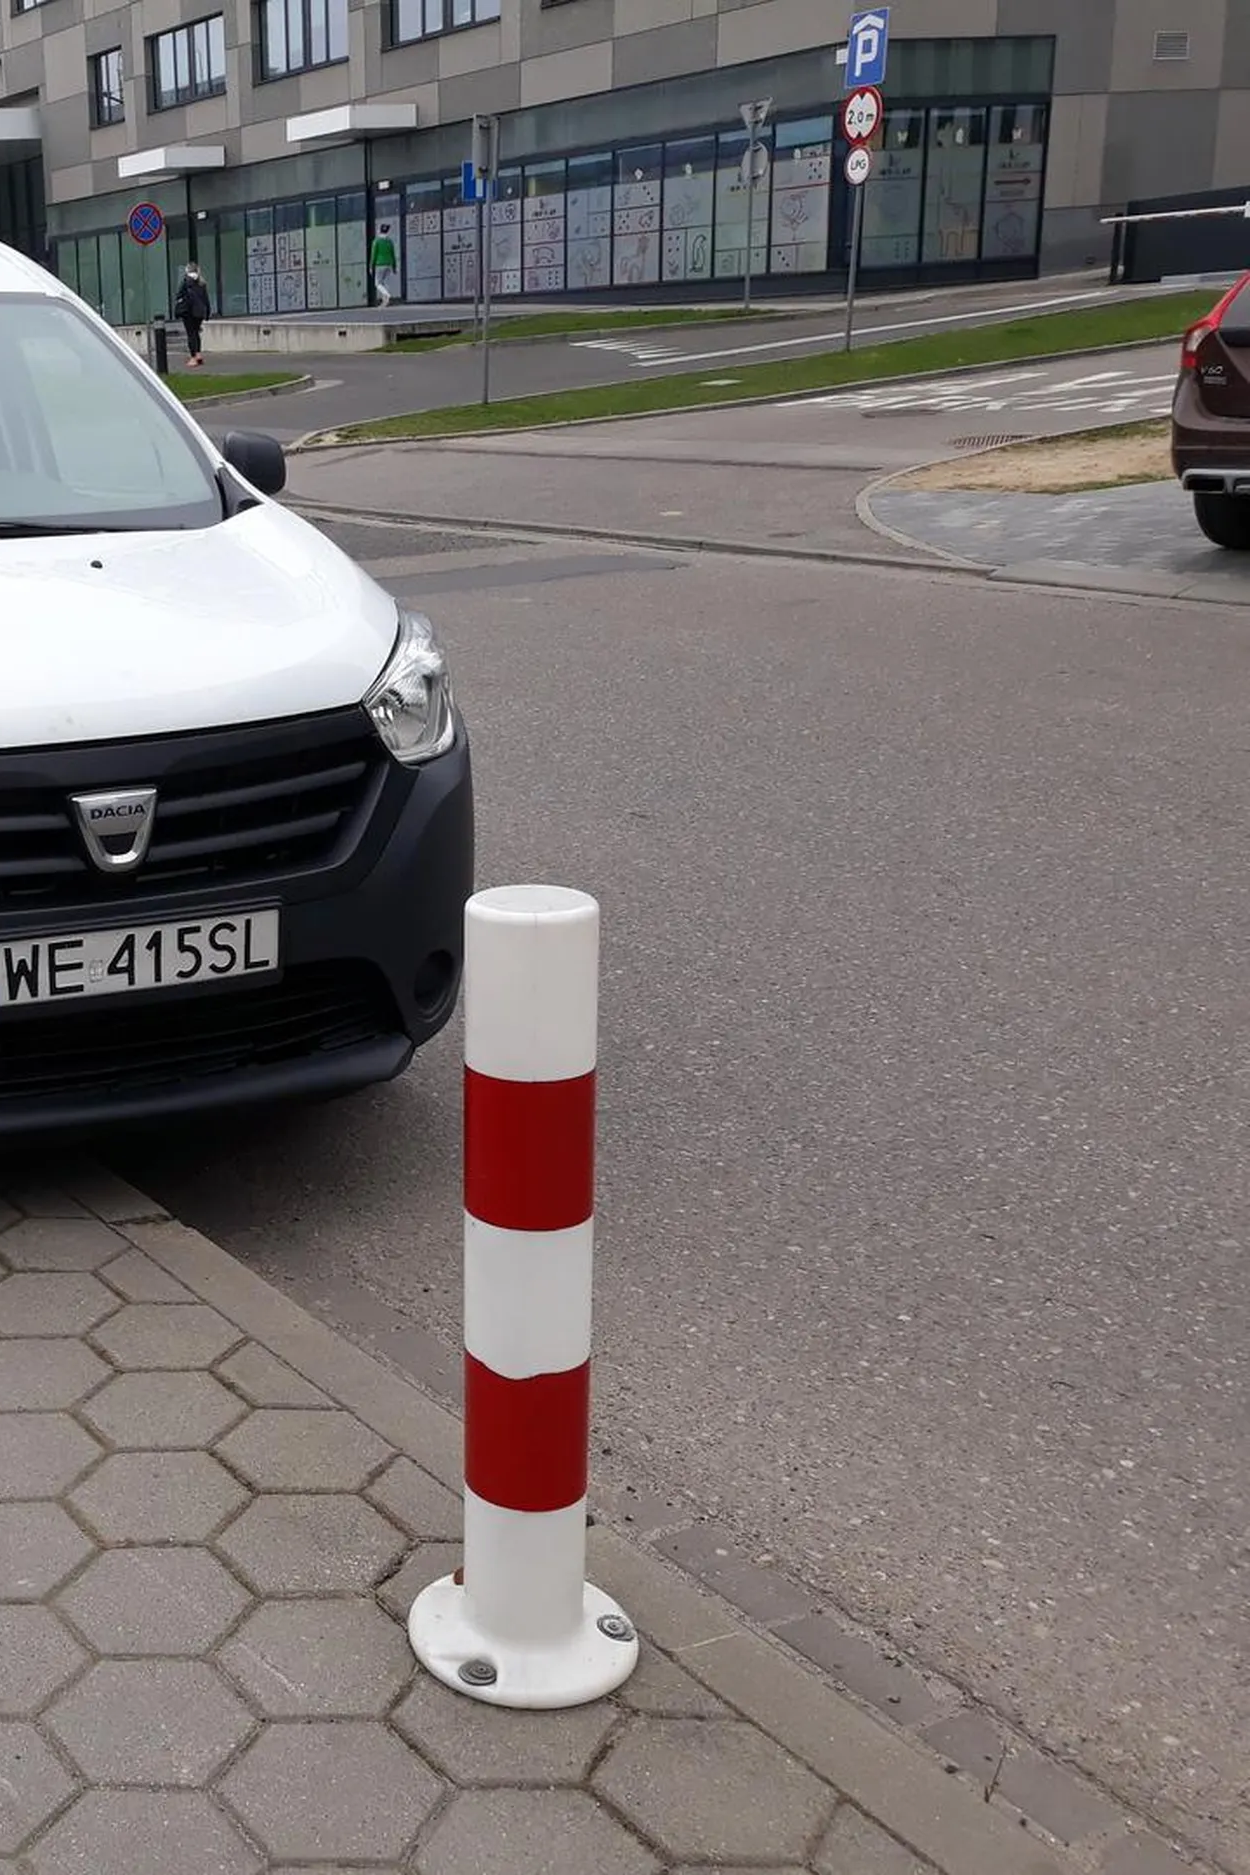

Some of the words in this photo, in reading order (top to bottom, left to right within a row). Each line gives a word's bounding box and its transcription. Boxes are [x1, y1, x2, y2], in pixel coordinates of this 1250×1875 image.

[1201, 365, 1224, 375] V60
[90, 803, 146, 821] DACIA
[3, 939, 85, 1001] WE
[106, 918, 271, 986] 415SL
